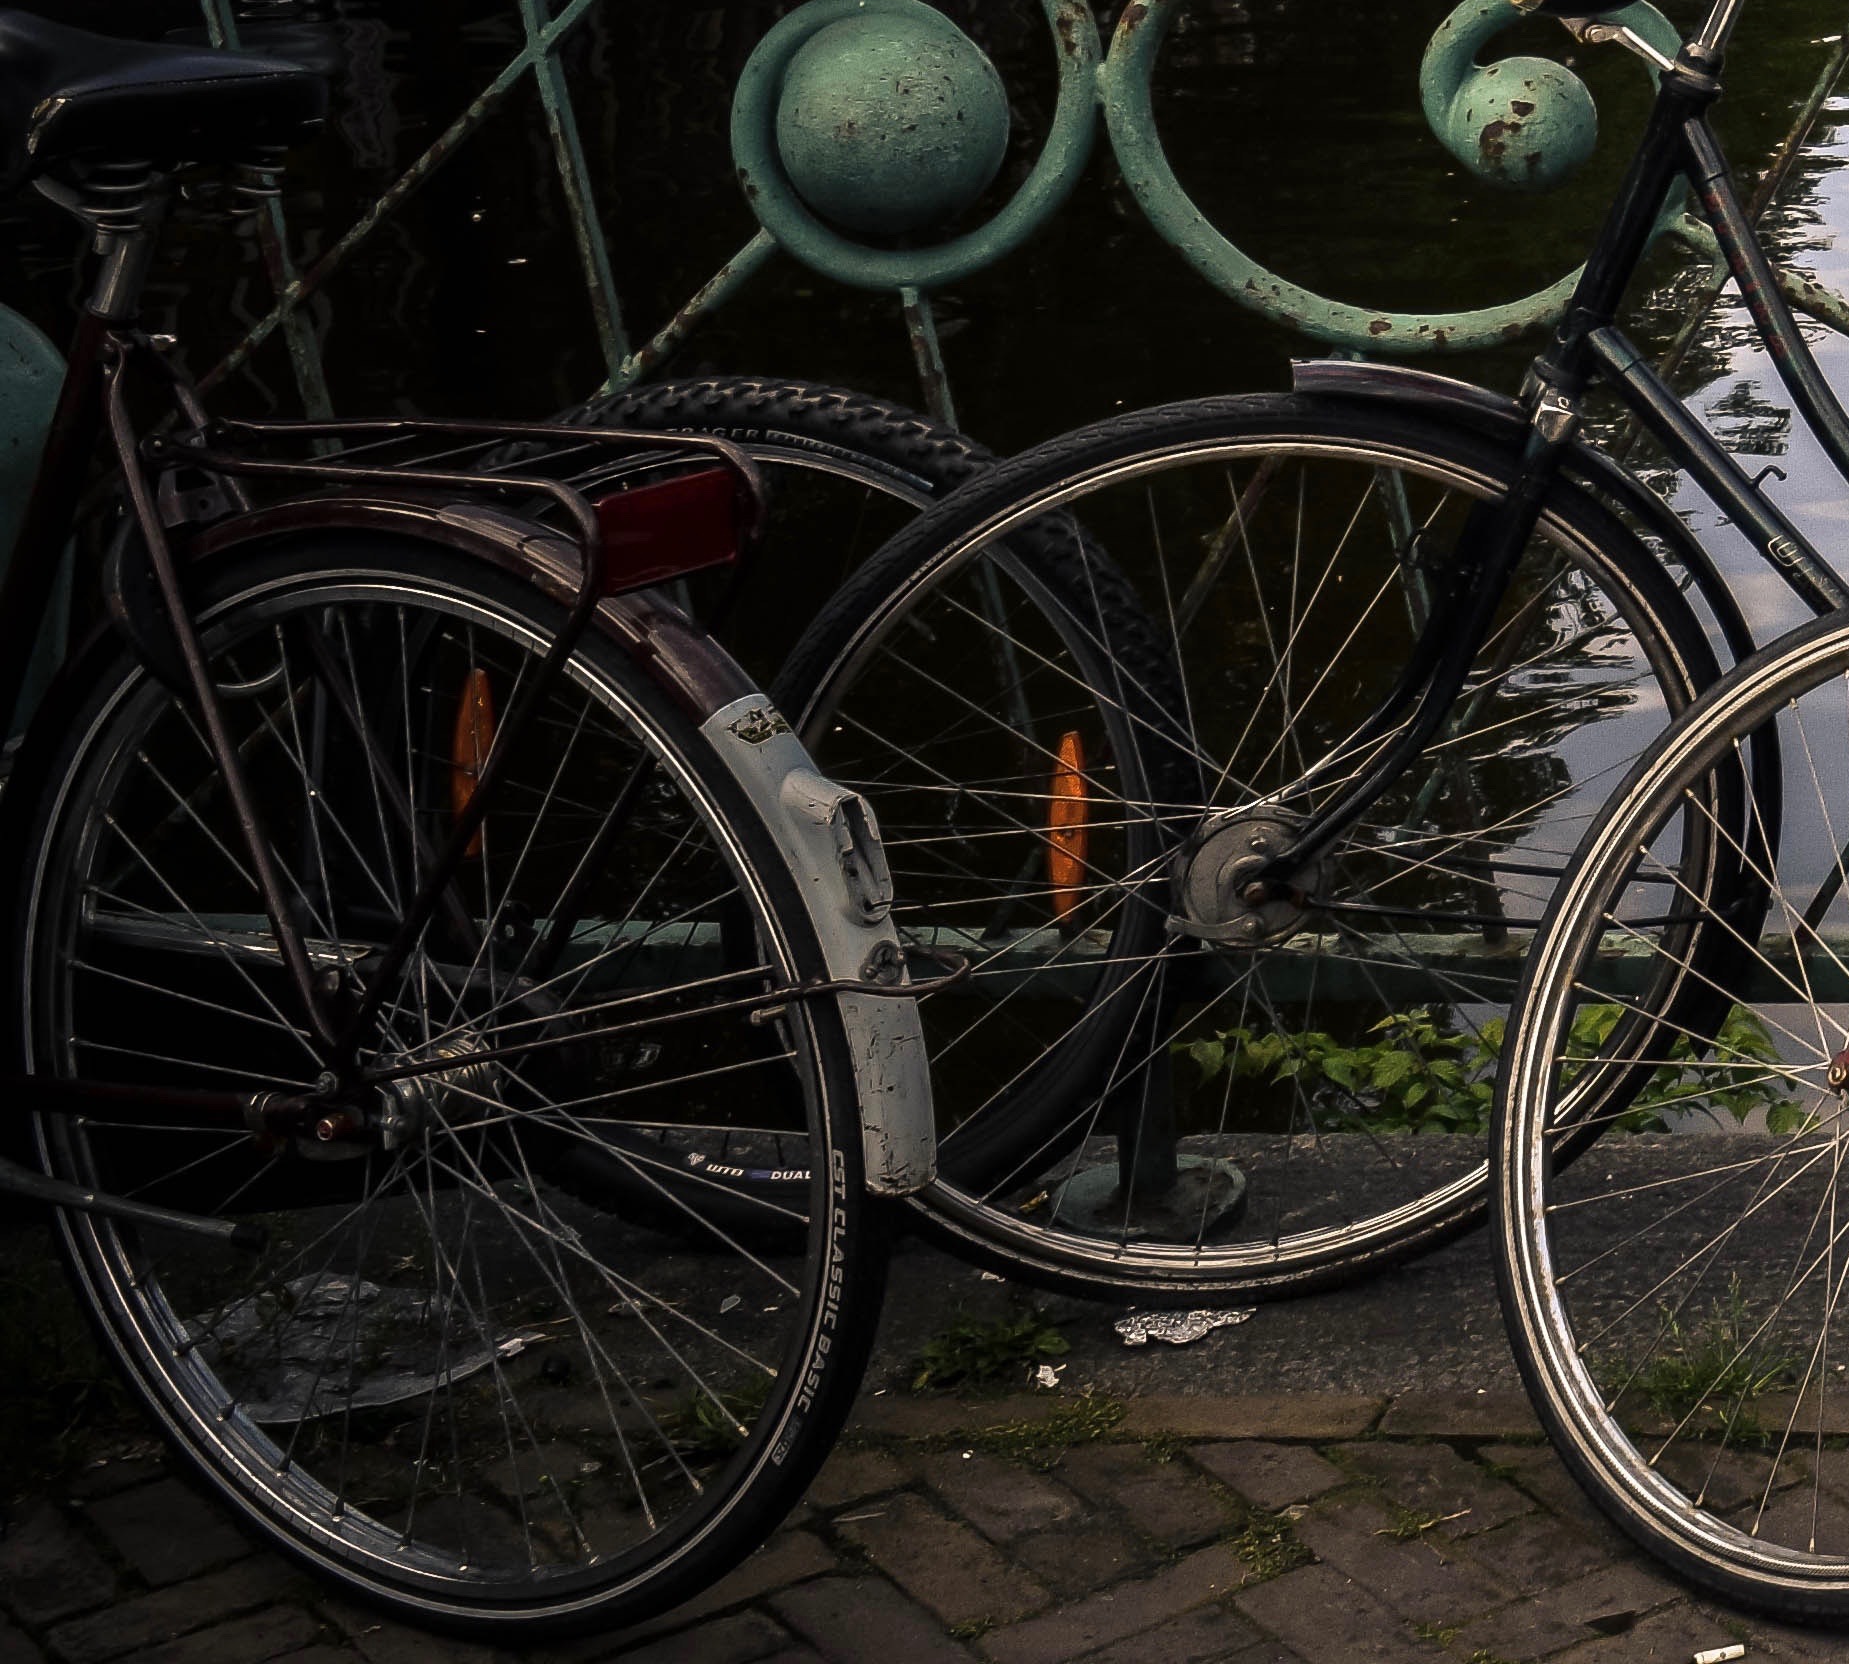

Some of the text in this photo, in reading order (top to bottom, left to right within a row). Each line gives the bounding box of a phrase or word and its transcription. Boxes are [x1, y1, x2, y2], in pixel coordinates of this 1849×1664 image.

[770, 1169, 814, 1181] DUAL
[796, 1148, 847, 1414] CST CLASSIC BASIC
